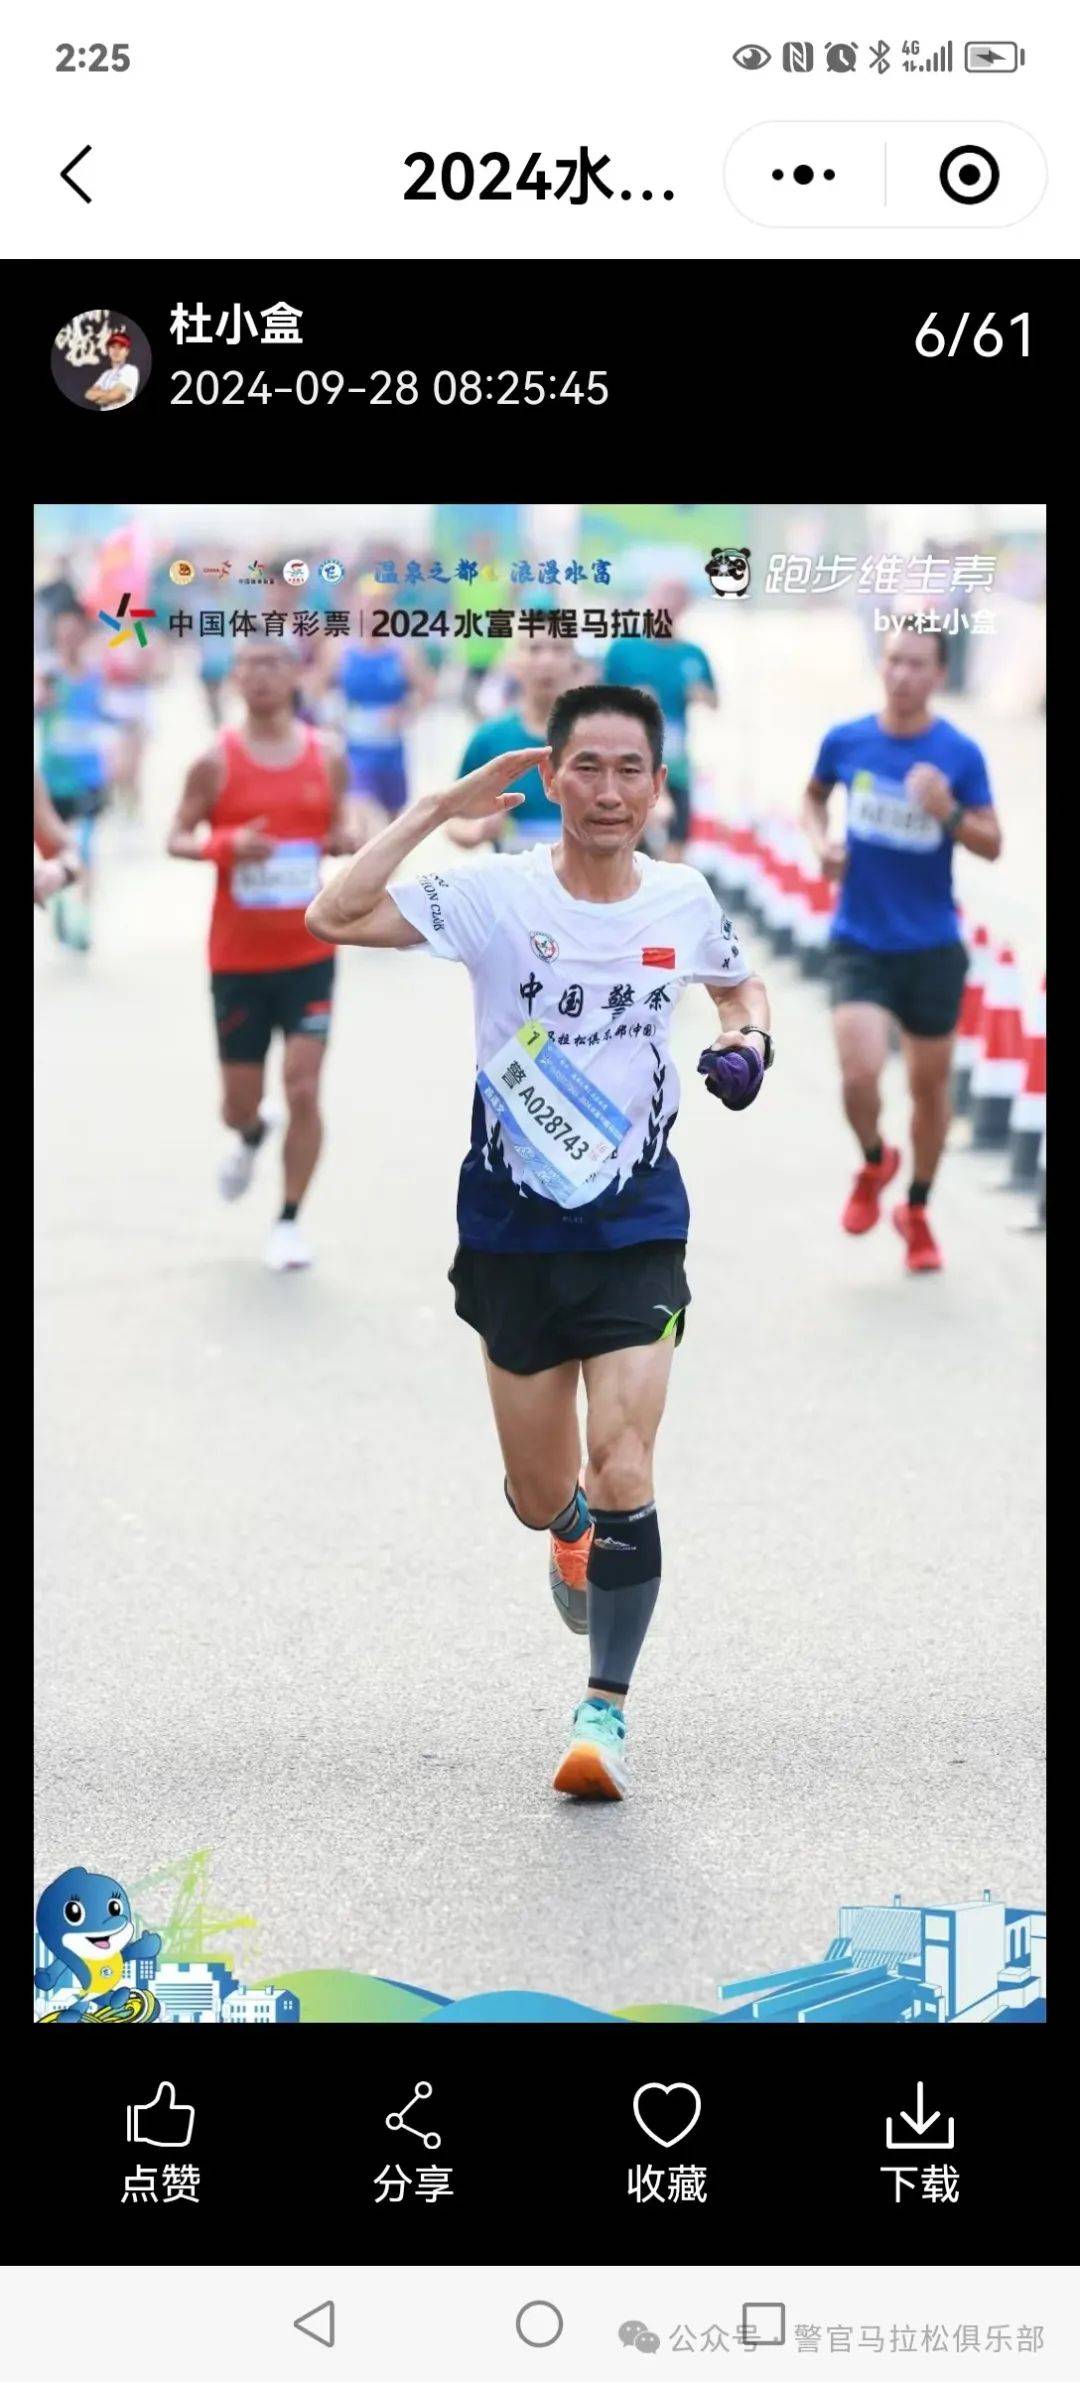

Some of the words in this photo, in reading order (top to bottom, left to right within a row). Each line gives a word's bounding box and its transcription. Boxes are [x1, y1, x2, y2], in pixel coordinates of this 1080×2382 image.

[56, 43, 131, 73] 2:25
[901, 39, 920, 56] 4G
[169, 301, 304, 345] 杜小盒
[915, 312, 1033, 358] 6/61
[170, 369, 419, 406] 2024-09-28
[433, 369, 609, 406] 08:25:45
[518, 1085, 590, 1161] A028743
[120, 2163, 201, 2204] 点赞
[373, 2163, 454, 2204] 分享
[627, 2163, 708, 2204] 收藏
[879, 2163, 960, 2204] 下载
